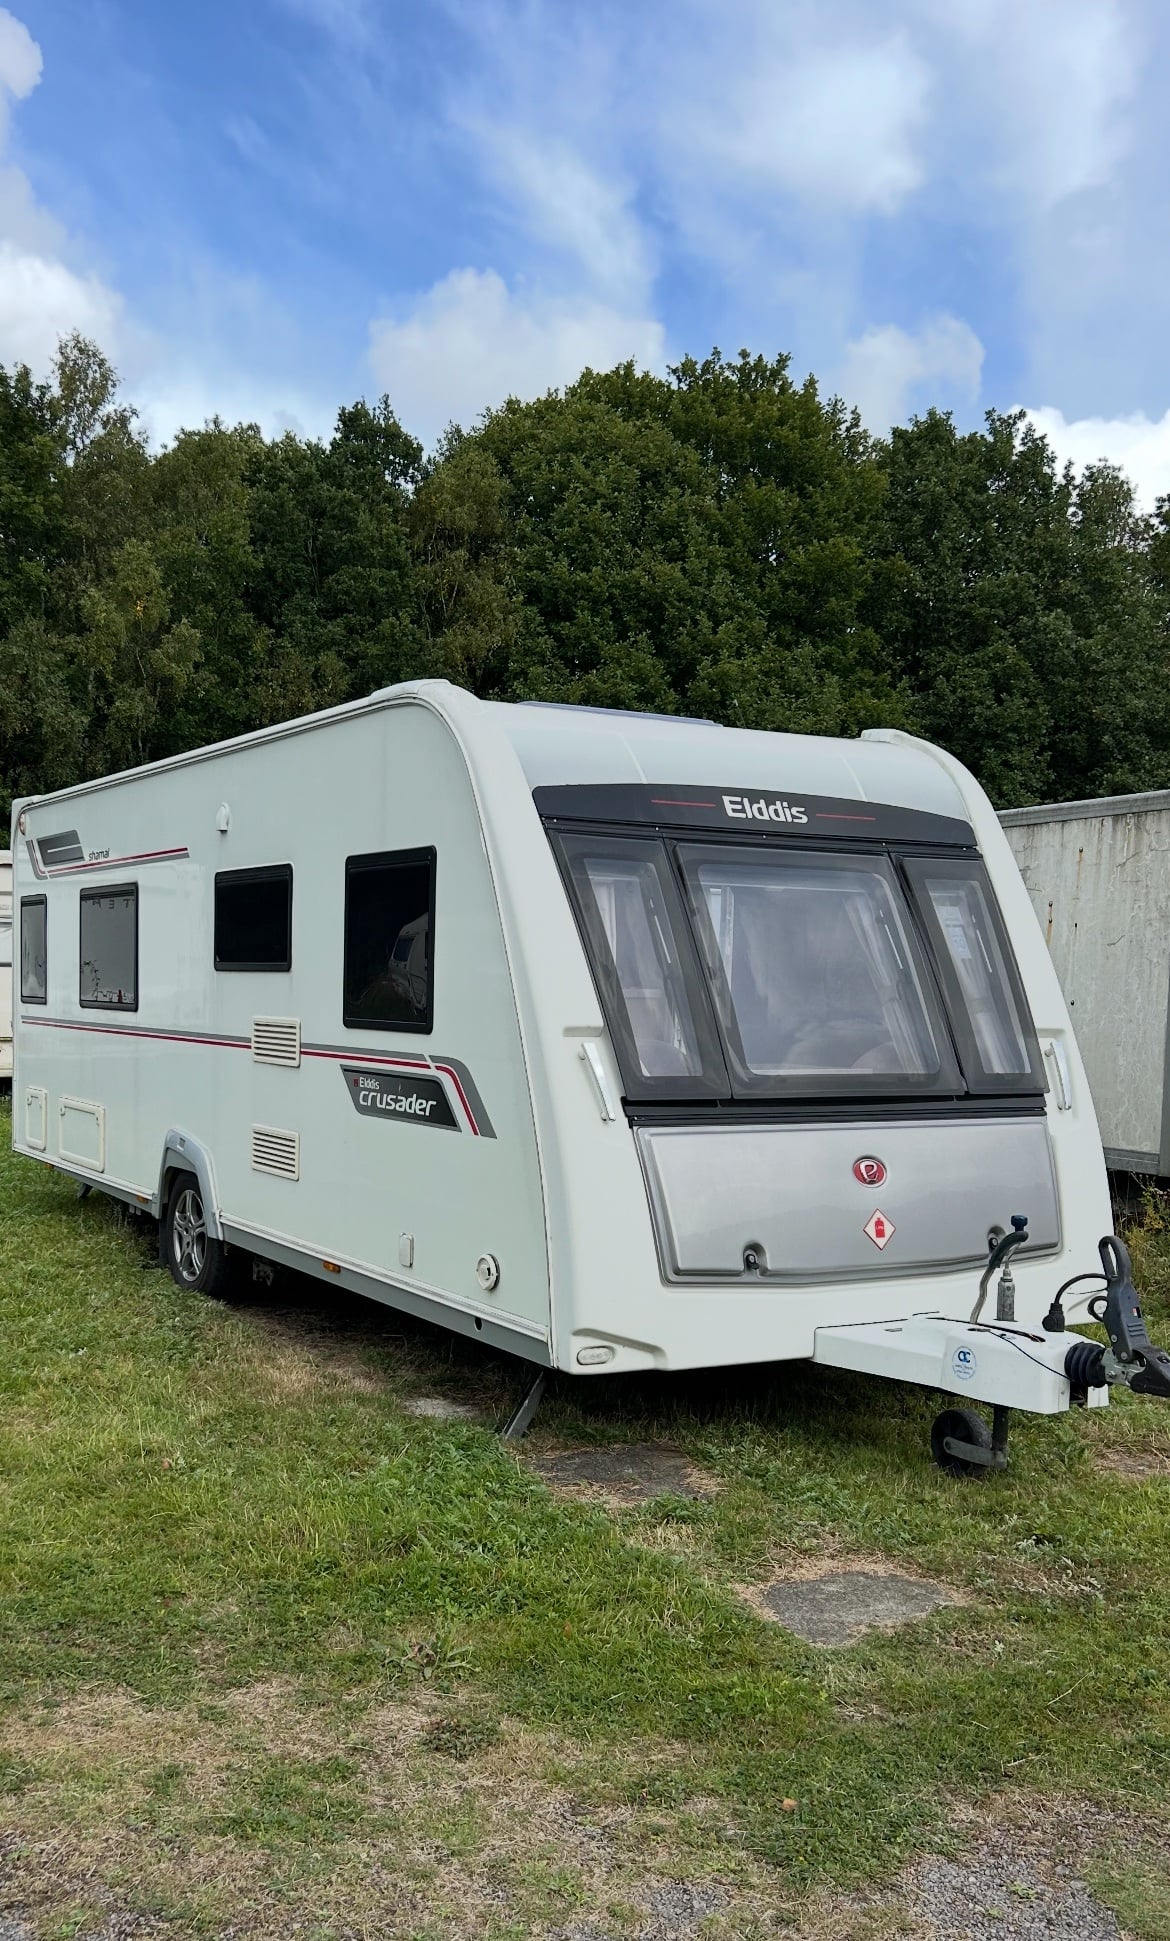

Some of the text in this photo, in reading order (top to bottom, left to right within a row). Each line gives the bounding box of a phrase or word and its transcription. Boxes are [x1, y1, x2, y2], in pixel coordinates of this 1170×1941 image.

[722, 795, 809, 824] Elddis
[88, 847, 111, 861] shamal
[358, 1076, 381, 1090] Elddis
[359, 1091, 437, 1117] crusader
